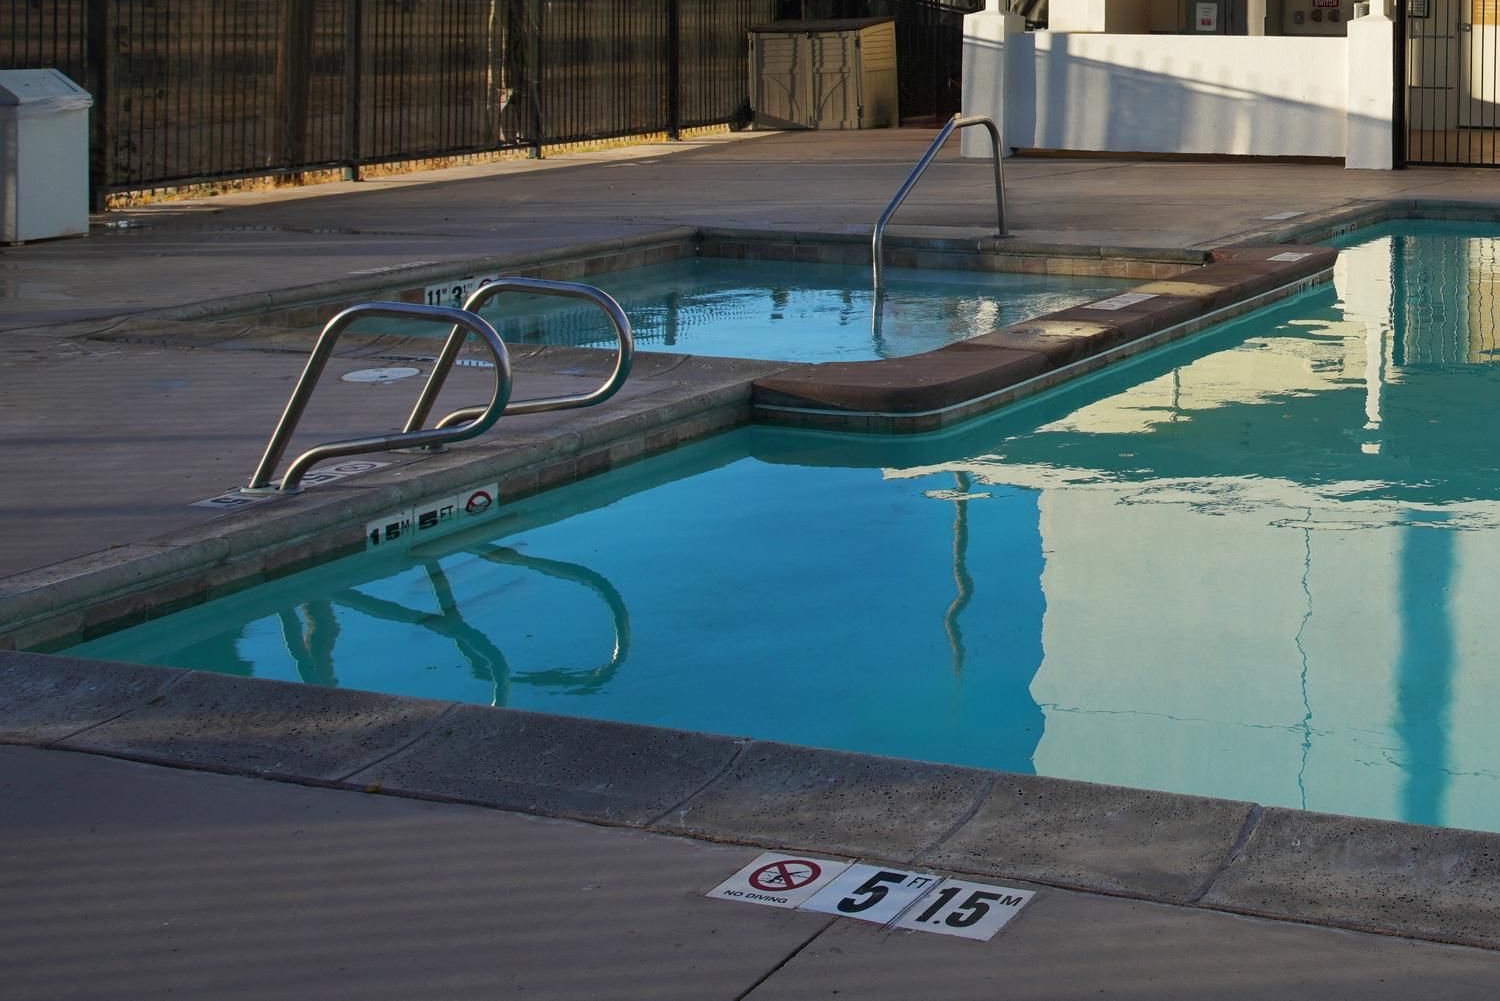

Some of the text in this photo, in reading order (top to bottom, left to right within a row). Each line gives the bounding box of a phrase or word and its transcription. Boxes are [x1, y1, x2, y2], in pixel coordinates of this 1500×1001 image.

[723, 889, 788, 904] NO DIVING
[837, 871, 1023, 929] 5 FT 1.5 M
